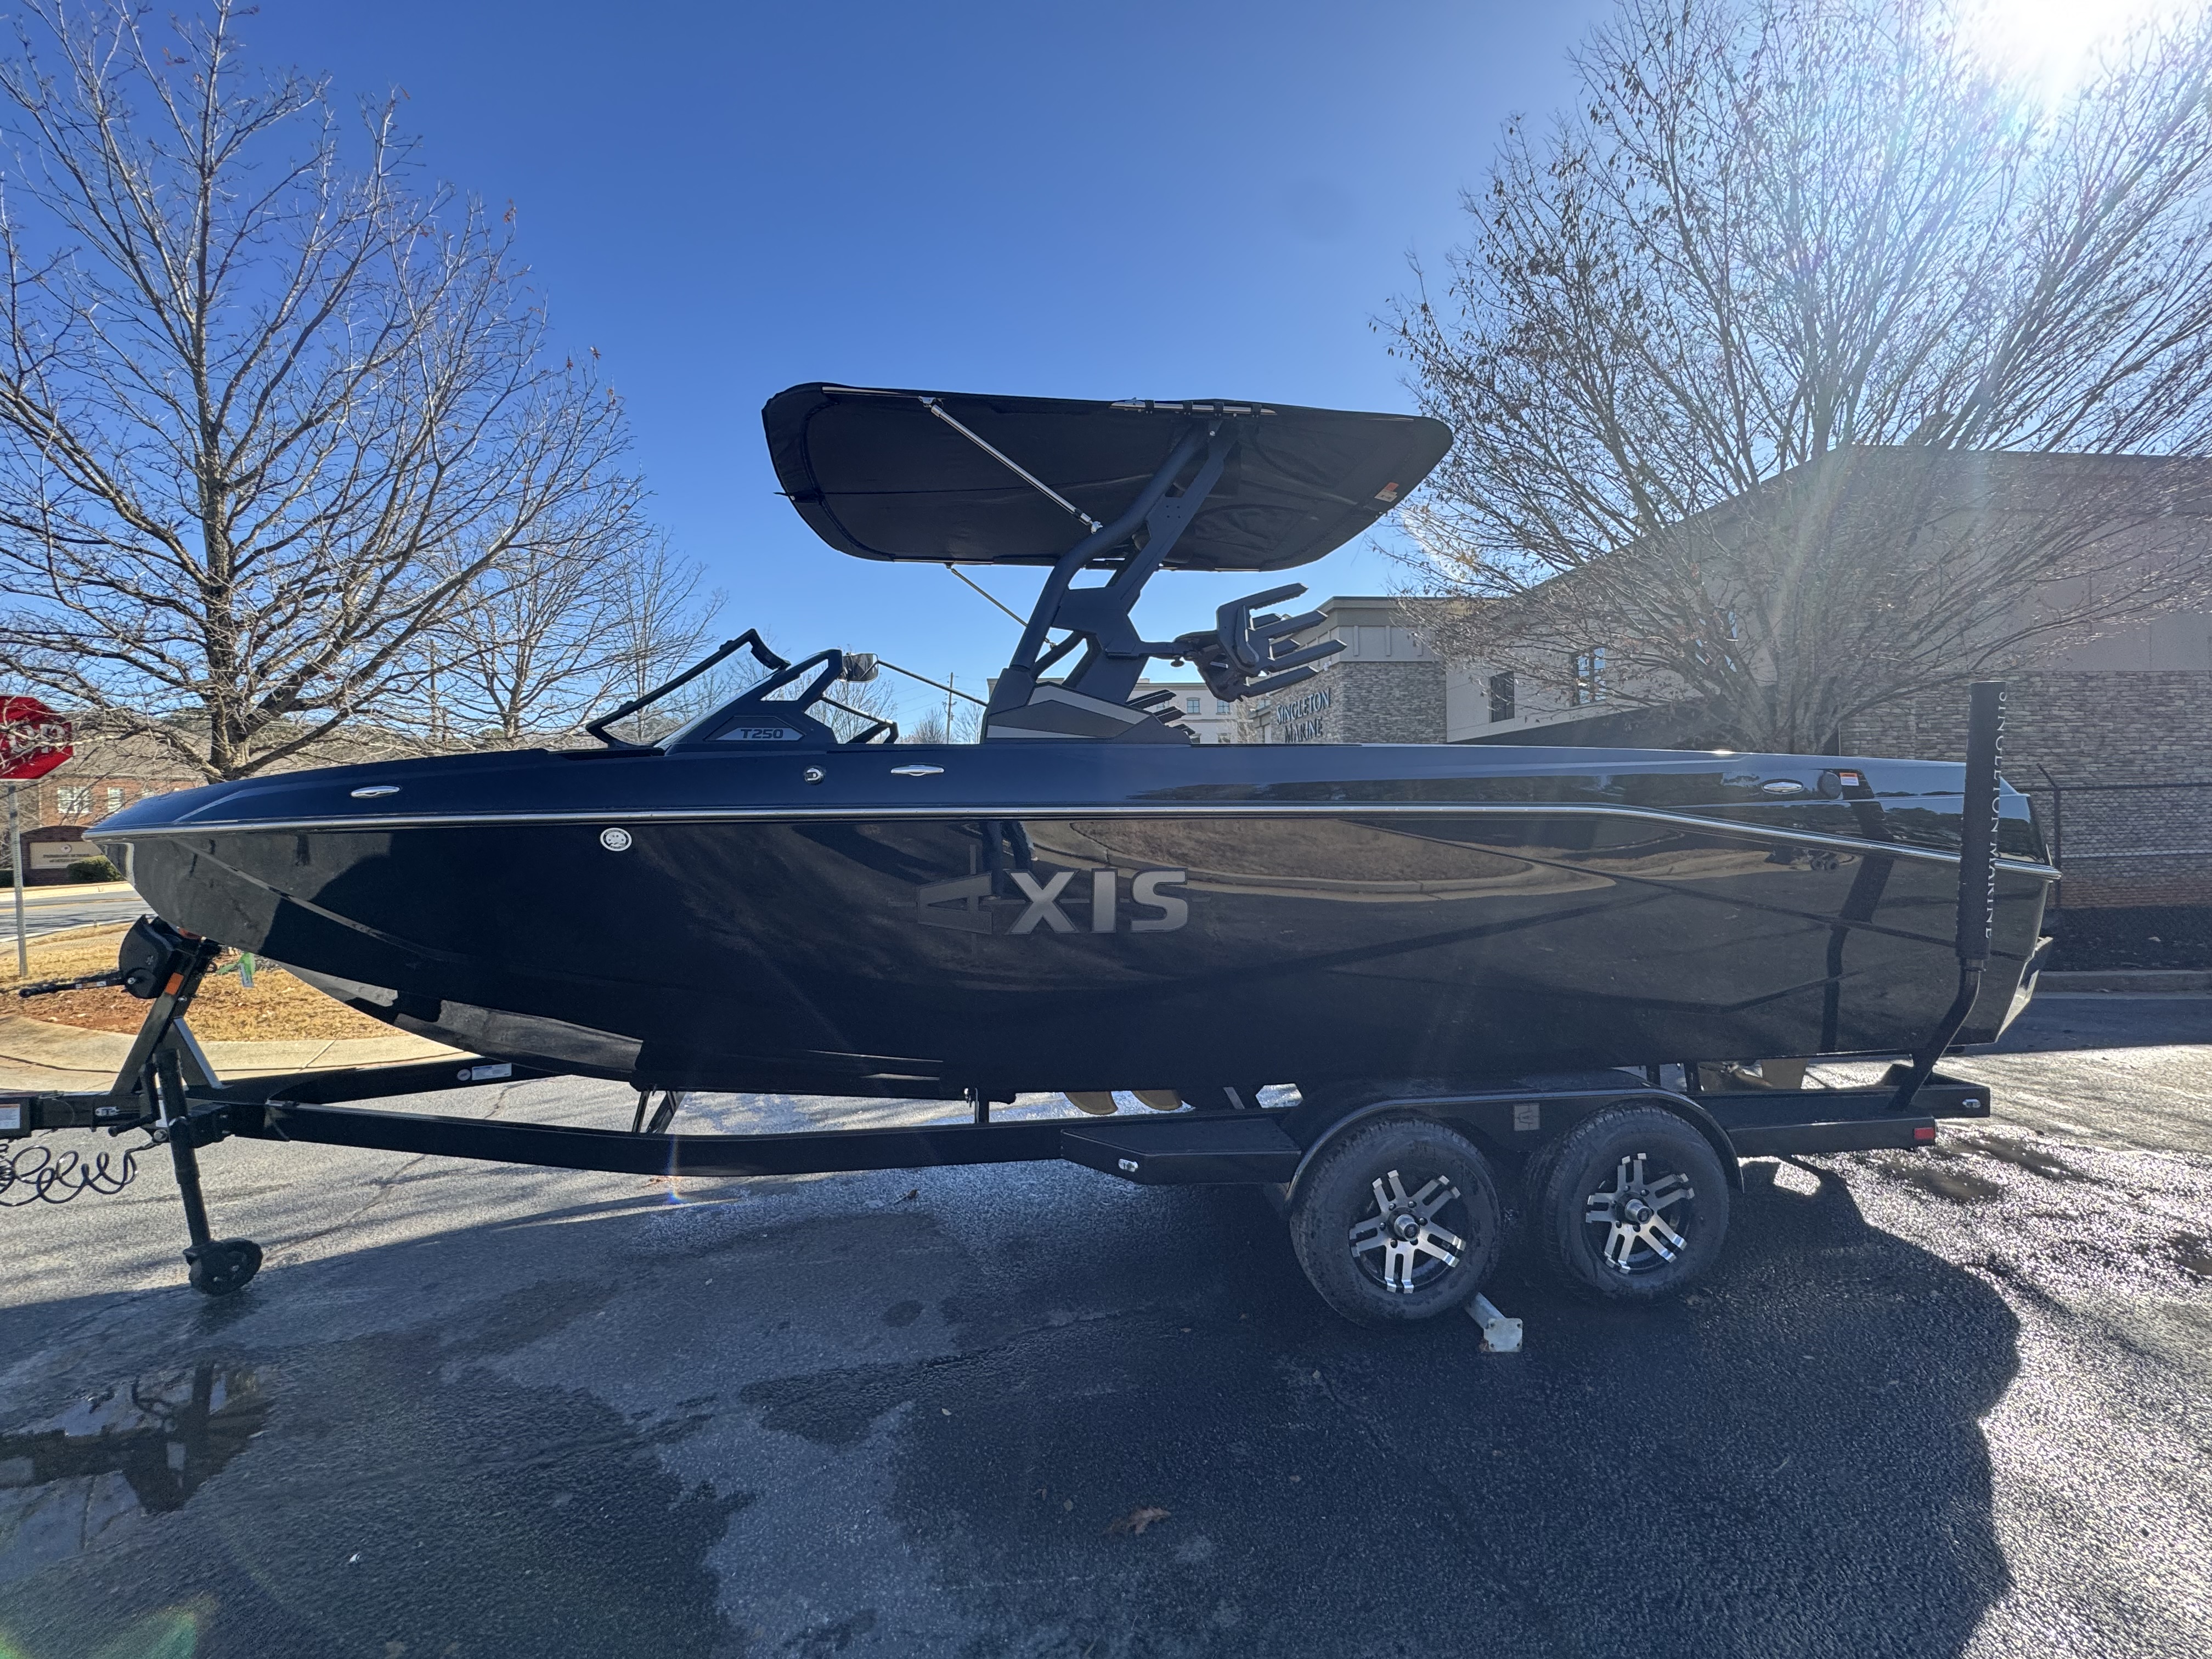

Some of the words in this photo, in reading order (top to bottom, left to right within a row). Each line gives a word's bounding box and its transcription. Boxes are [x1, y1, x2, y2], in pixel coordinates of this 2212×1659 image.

[1277, 687, 1330, 725] SINGLETON
[741, 729, 784, 739] T250
[1285, 716, 1322, 743] MARINE
